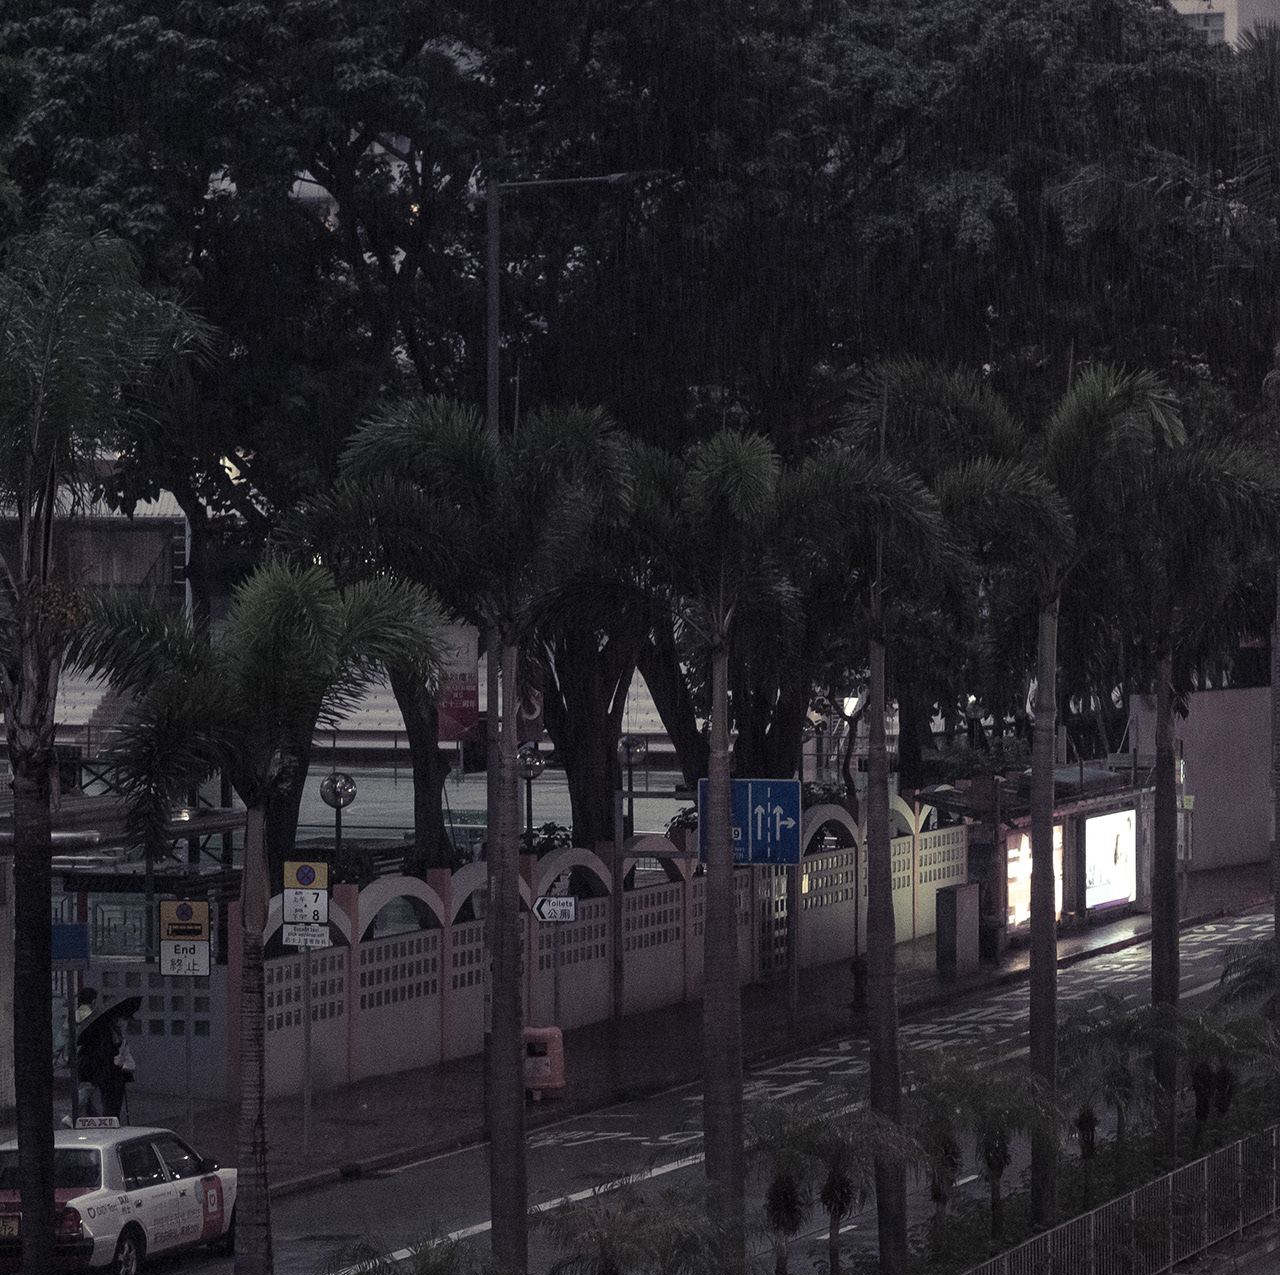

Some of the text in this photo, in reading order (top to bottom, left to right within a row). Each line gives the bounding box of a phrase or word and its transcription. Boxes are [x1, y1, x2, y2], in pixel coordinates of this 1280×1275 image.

[312, 892, 320, 903] 7
[547, 899, 573, 907] Toilets
[312, 909, 320, 921] 8
[174, 944, 196, 954] End
[170, 958, 200, 974] 終止
[79, 1117, 116, 1127] TAXI
